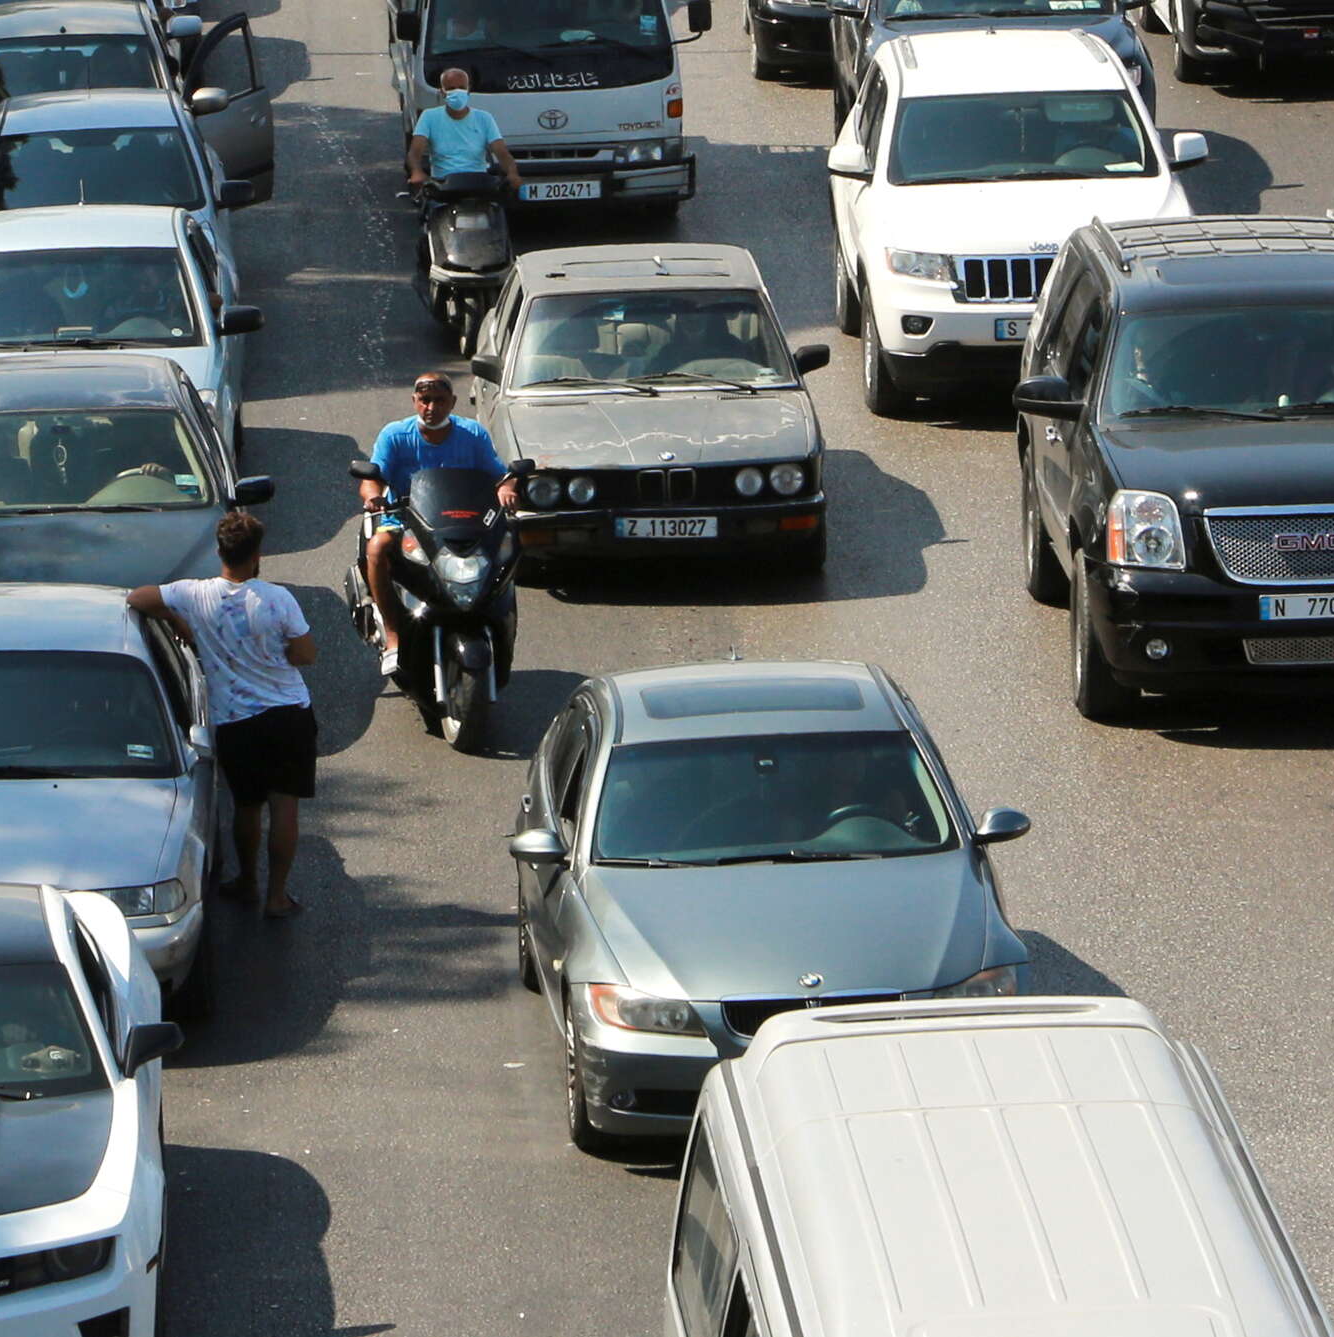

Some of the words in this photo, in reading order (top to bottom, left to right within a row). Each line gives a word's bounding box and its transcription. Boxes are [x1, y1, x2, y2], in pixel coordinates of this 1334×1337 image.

[529, 184, 538, 198] M
[546, 183, 591, 198] 202471
[1029, 239, 1059, 253] Jeep
[1008, 321, 1017, 336] S
[628, 520, 638, 536] Z
[650, 519, 707, 536] 113027
[1275, 599, 1286, 617] N
